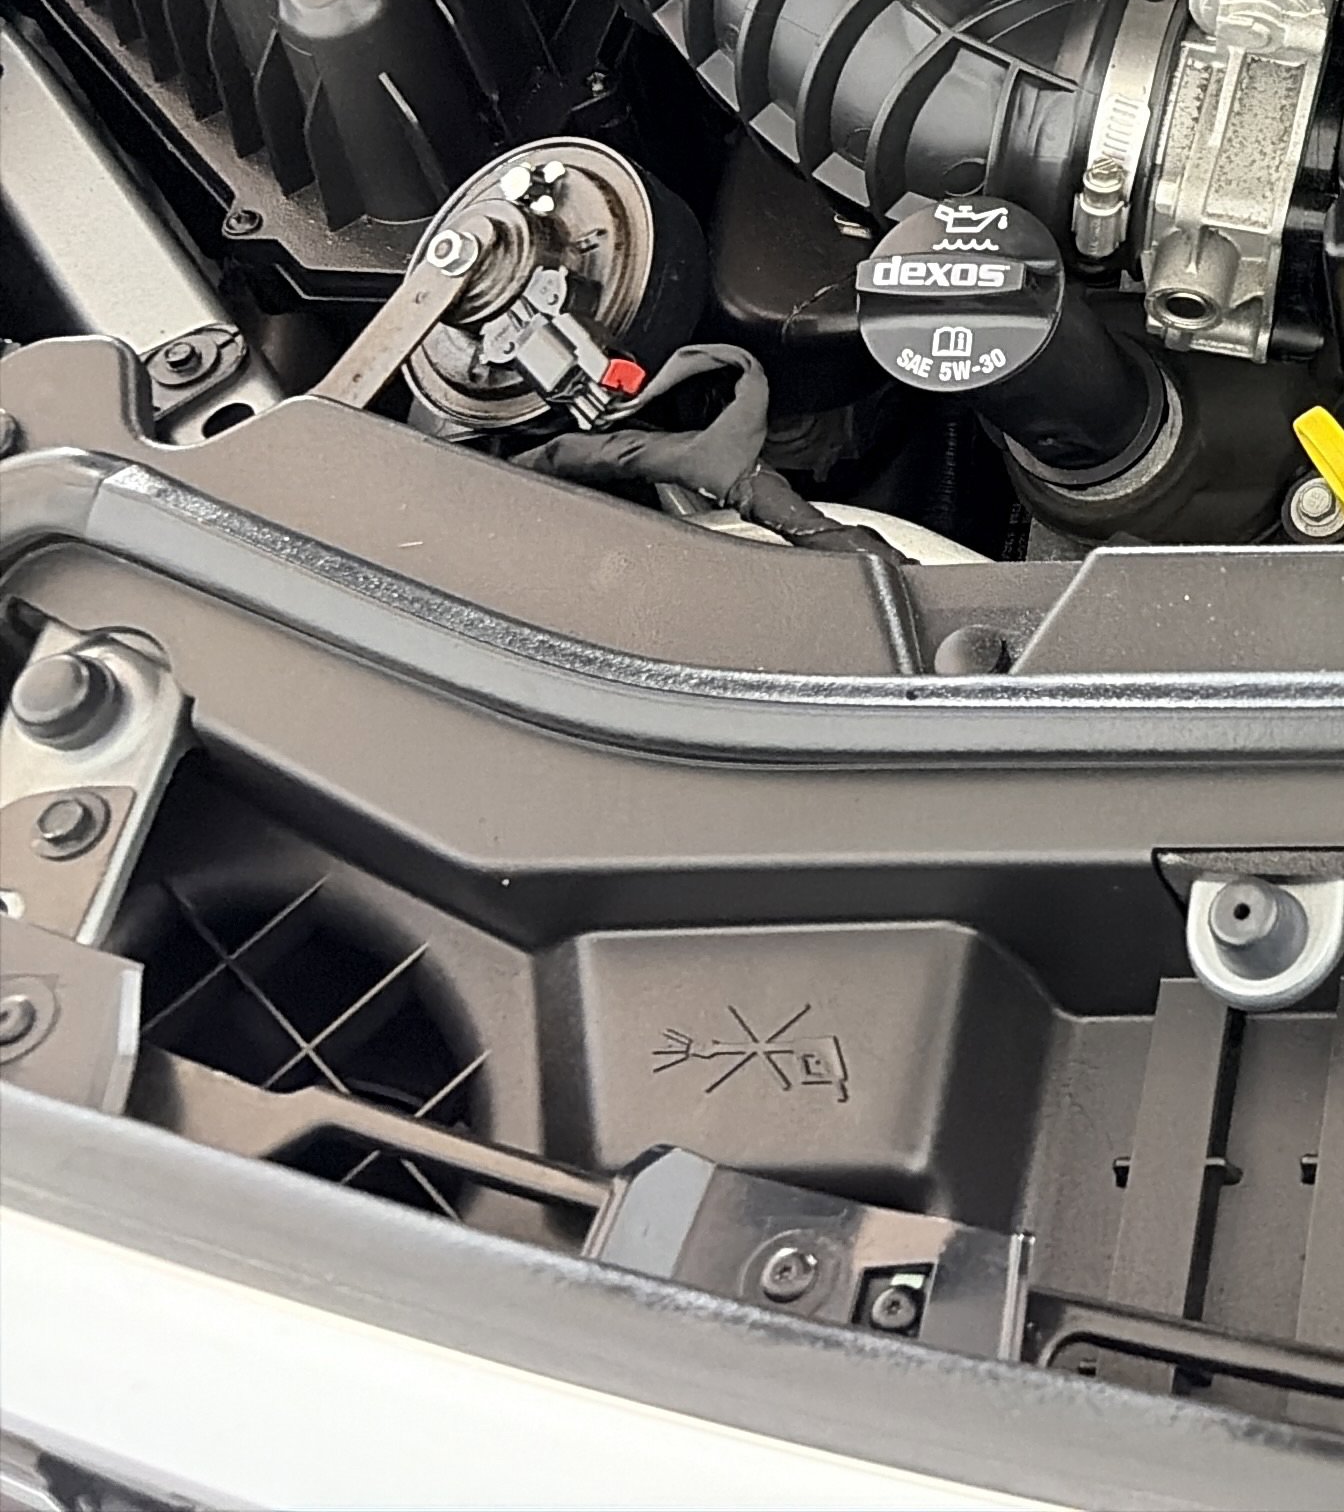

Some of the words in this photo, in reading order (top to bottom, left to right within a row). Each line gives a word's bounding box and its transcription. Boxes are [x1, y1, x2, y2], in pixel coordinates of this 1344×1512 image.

[873, 255, 1006, 288] dexos
[896, 348, 934, 379] SAE
[938, 348, 1007, 382] 5W-30
